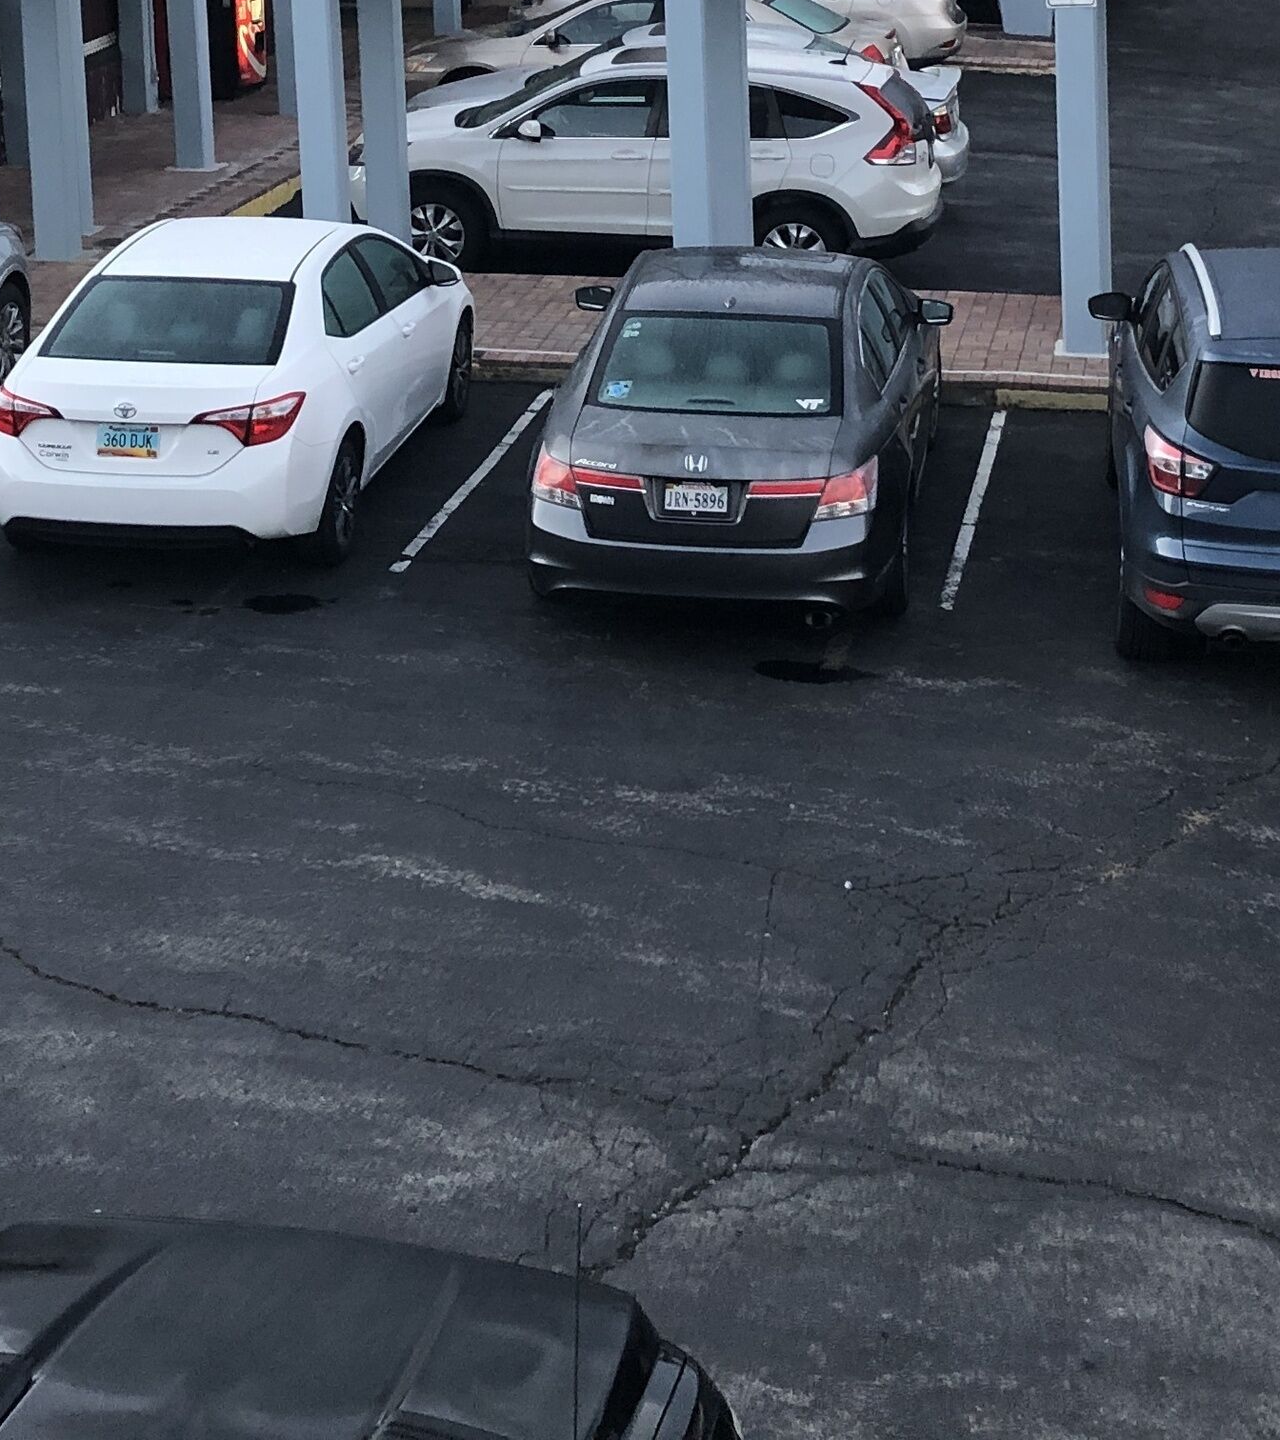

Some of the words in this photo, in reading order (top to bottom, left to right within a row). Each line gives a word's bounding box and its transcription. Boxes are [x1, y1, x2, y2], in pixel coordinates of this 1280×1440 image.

[795, 398, 824, 410] VT
[103, 432, 127, 448] 360
[130, 433, 153, 449] DJK
[574, 458, 617, 470] Accord
[666, 491, 725, 510] JRN-5896
